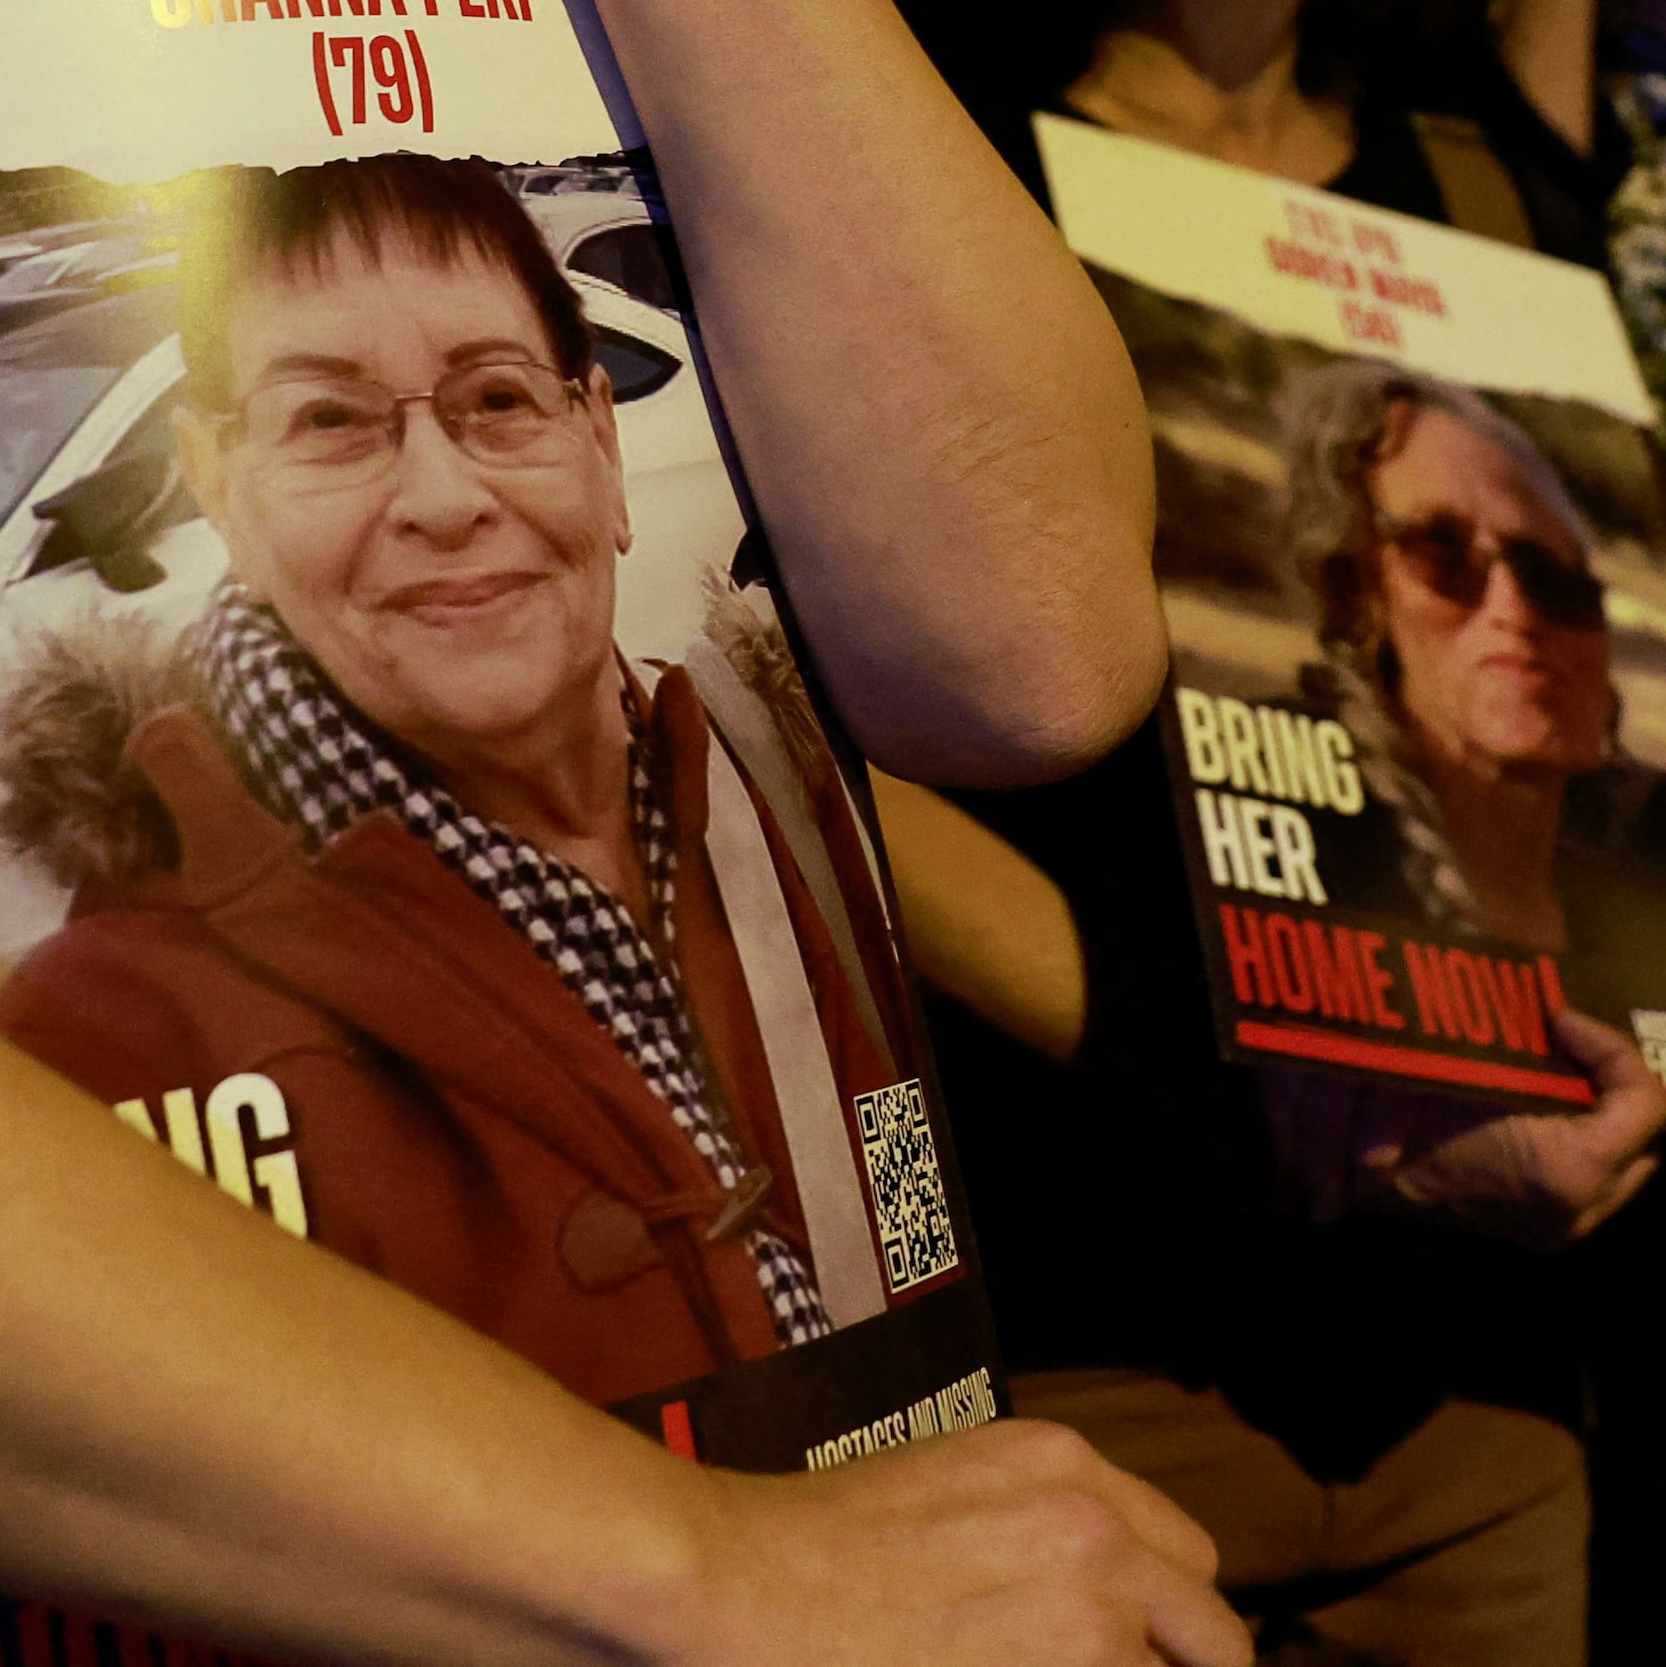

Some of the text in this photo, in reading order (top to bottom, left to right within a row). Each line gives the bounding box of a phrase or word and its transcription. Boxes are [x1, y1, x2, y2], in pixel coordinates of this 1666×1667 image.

[312, 30, 435, 137] (79)
[1175, 686, 1365, 817] BRING
[1195, 787, 1329, 906] HER
[1218, 903, 1406, 1031] HOME
[907, 1396, 940, 1440] AND
[935, 1366, 997, 1434] MISSING
